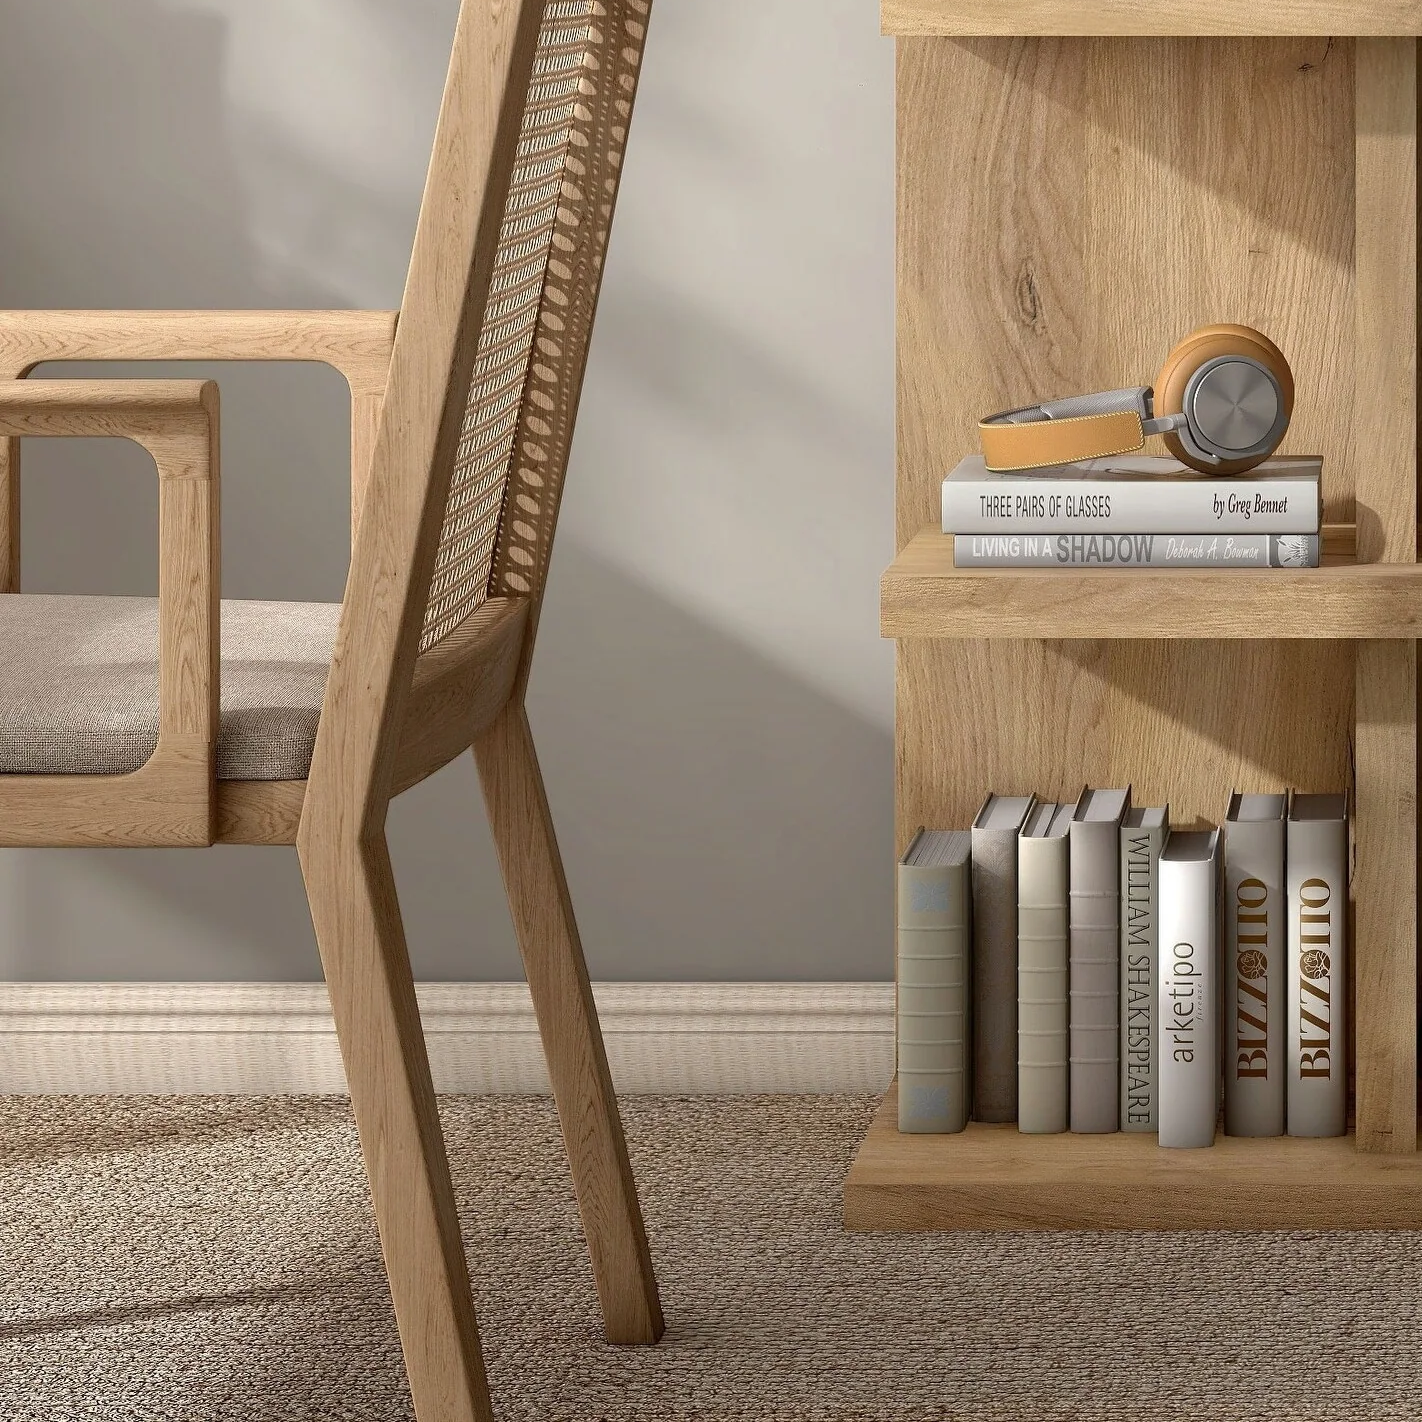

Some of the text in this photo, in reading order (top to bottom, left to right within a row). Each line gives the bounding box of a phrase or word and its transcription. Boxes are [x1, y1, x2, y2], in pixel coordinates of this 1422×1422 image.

[980, 493, 1288, 520] THREE PAIRS OF GLASSES by Greg Bennet
[972, 537, 1020, 558] LIVING
[1024, 537, 1039, 558] IN
[1041, 537, 1053, 558] A
[1056, 534, 1154, 563] SHADOW
[1165, 537, 1204, 560] Deborah
[1222, 537, 1259, 560] Bowman
[1127, 833, 1150, 1124] WILLIAM SHAKESPEARE
[1165, 942, 1202, 1063] arketipo
